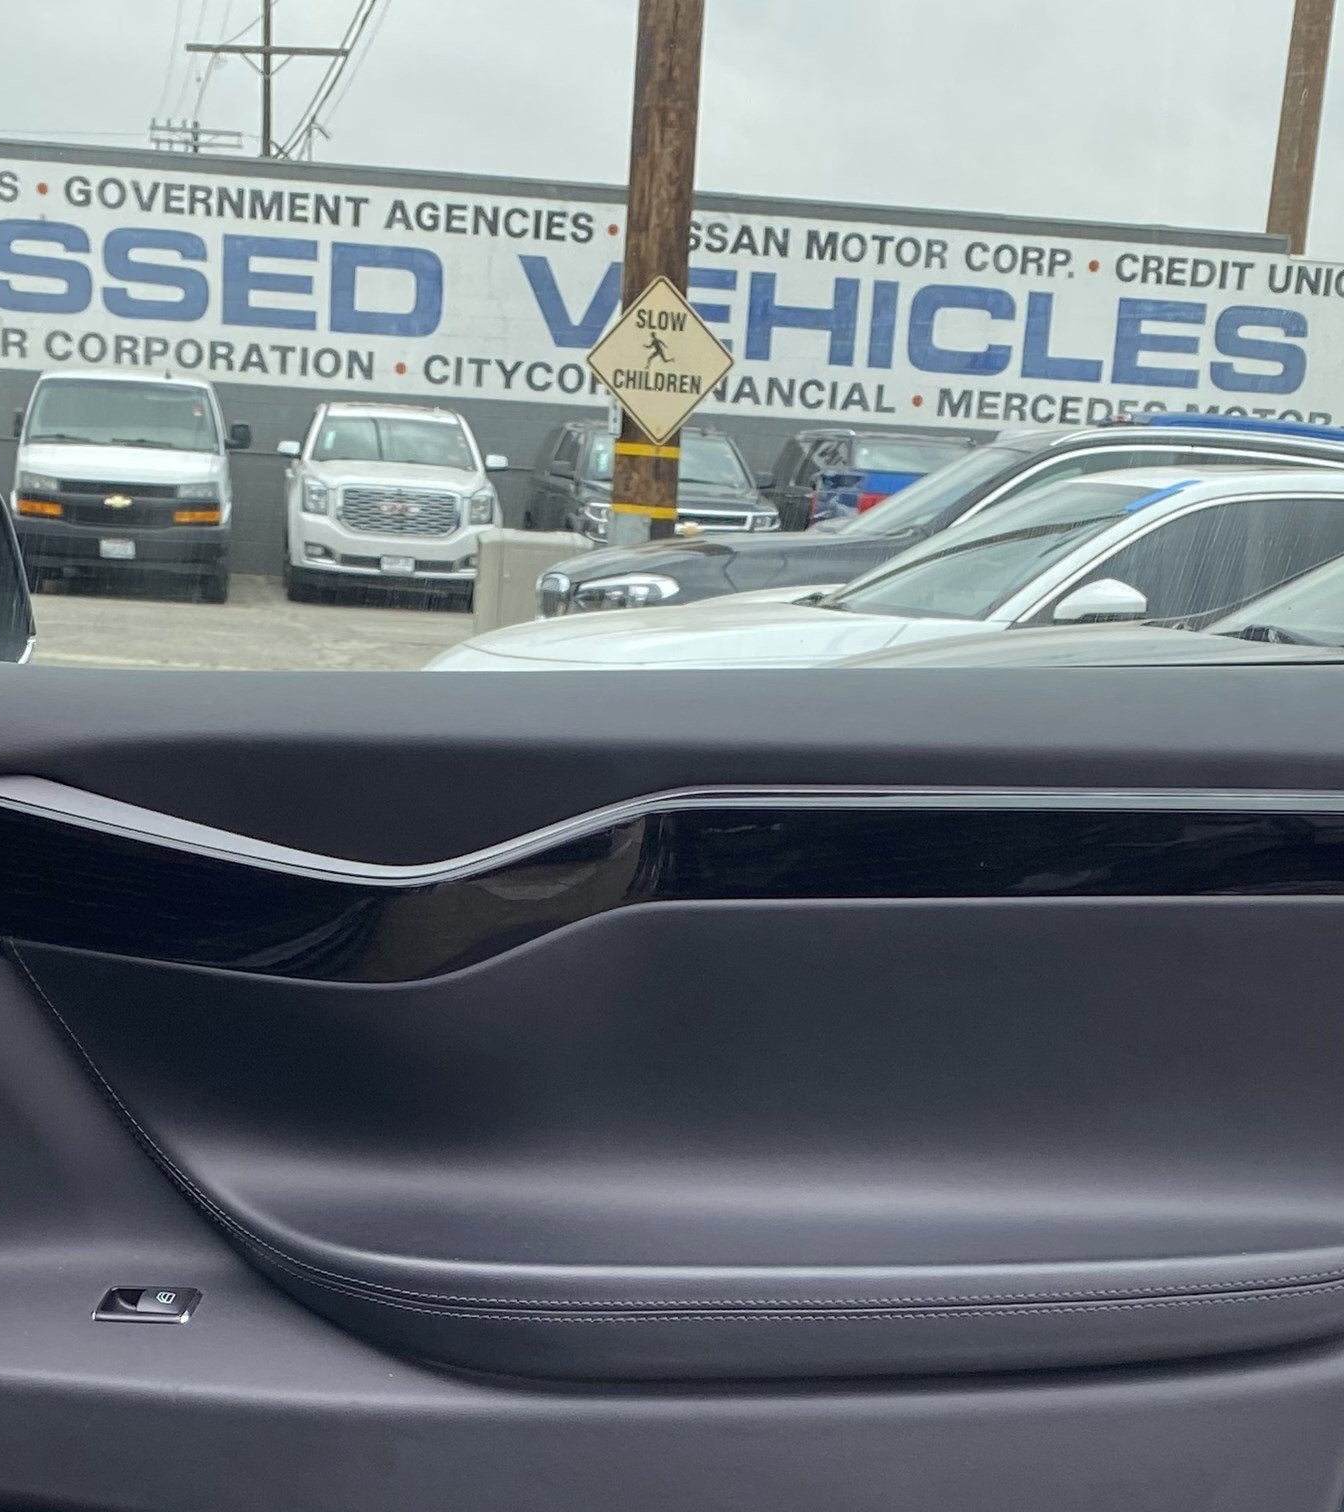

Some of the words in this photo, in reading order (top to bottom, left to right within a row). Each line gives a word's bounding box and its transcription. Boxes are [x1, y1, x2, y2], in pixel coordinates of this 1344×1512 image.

[63, 174, 369, 228] GOVERNMENT
[385, 198, 595, 244] AGENCIES
[689, 219, 790, 259] SSAN
[805, 228, 949, 270] MOTOR
[964, 241, 1075, 279] CORP.
[1115, 252, 1255, 292] CREDIT
[636, 308, 687, 332] SLOW
[44, 330, 376, 381] CORPORATION
[422, 354, 611, 396] CITYCO
[712, 374, 896, 415] ANCIAL
[612, 368, 702, 395] CHILDREN
